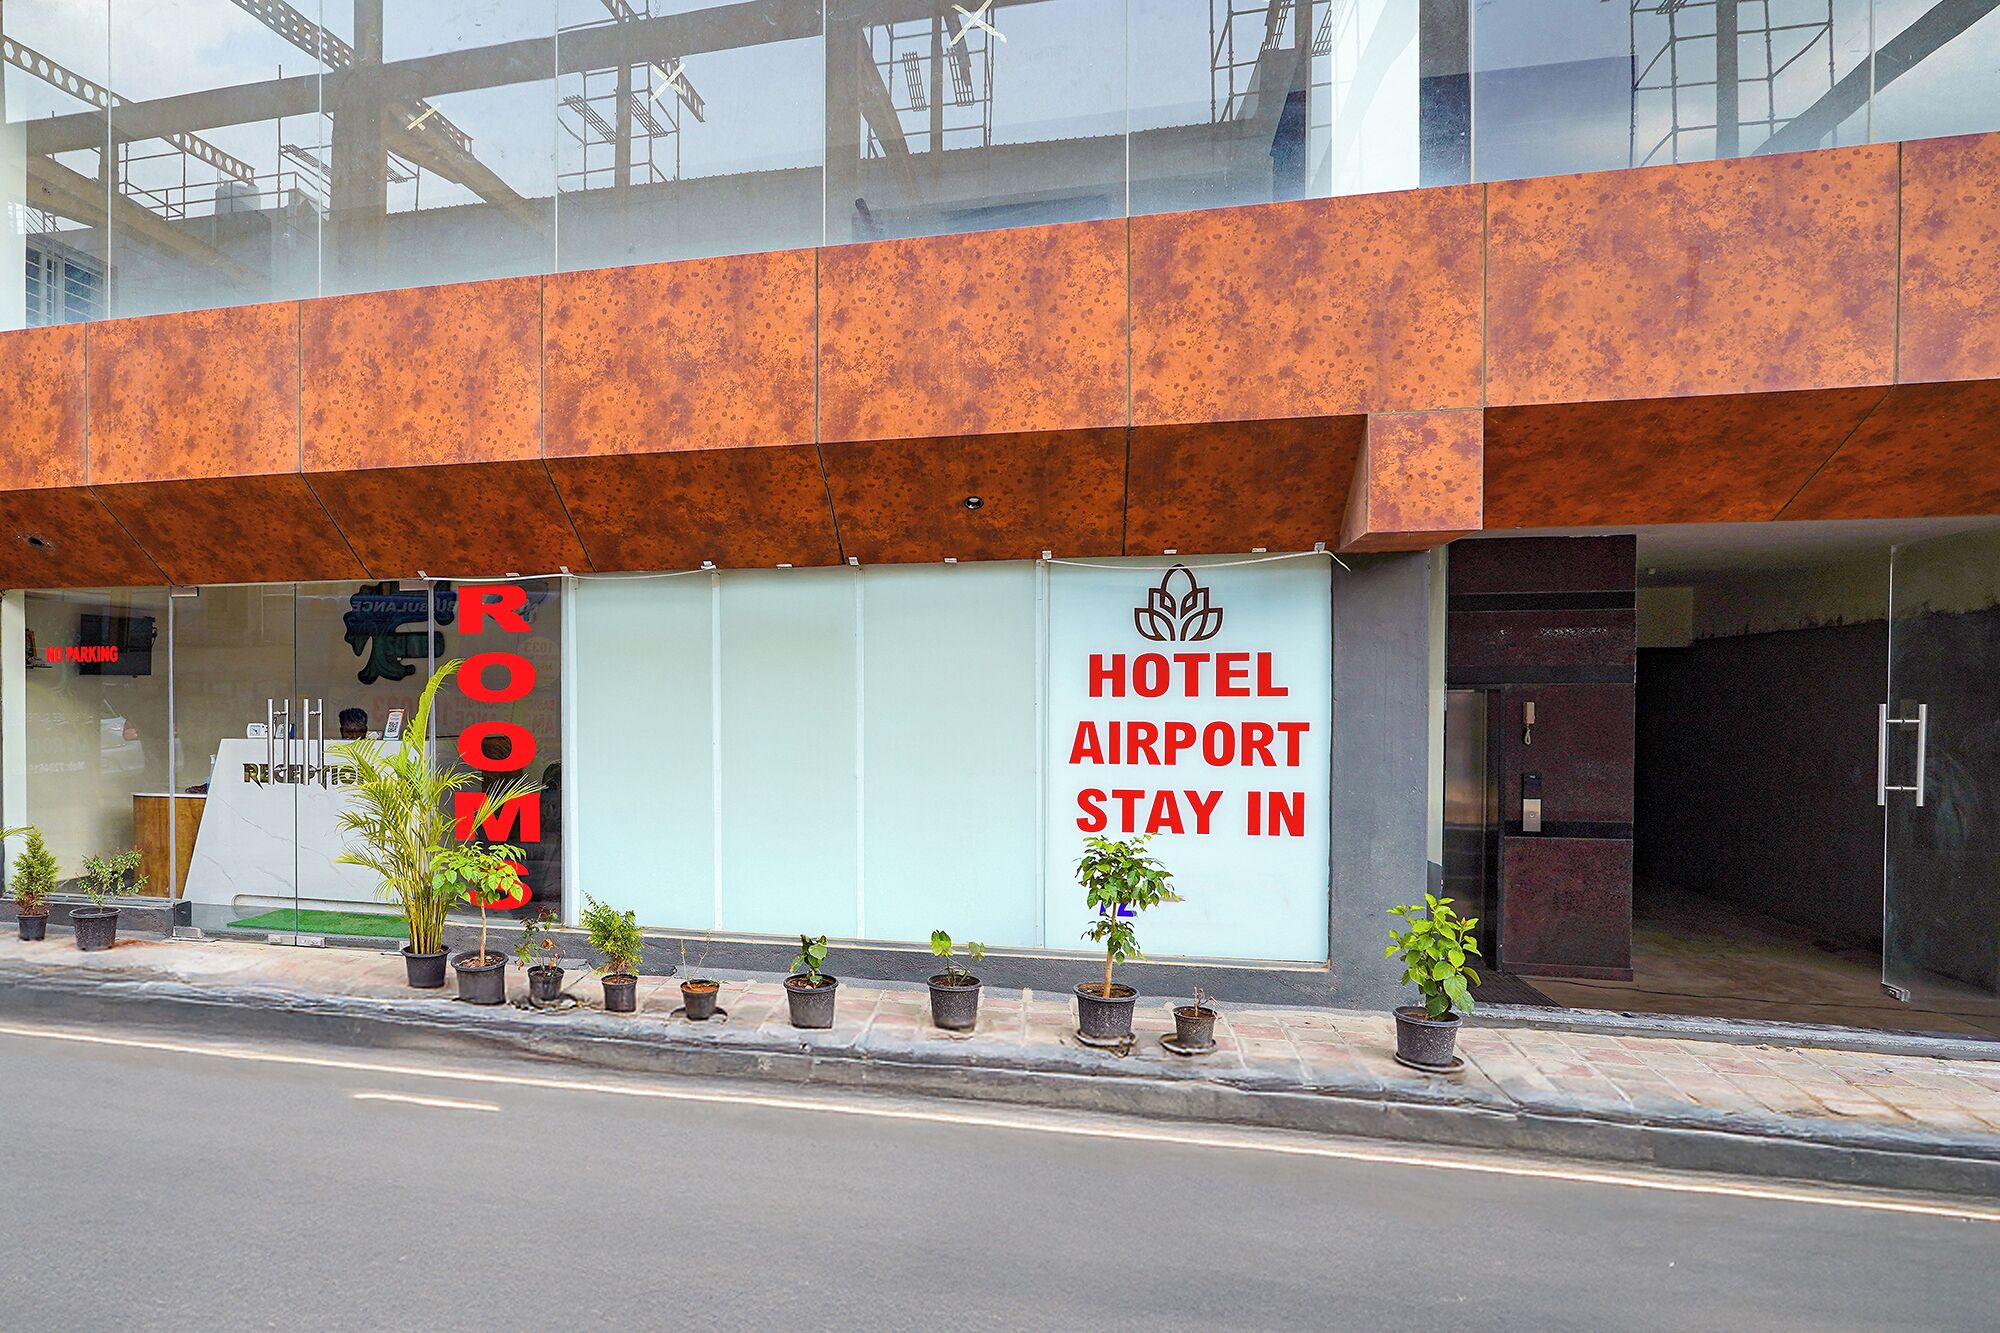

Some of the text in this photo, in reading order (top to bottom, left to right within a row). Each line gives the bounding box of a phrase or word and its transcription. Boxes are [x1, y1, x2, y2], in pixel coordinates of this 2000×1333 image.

[45, 645, 119, 663] NO PARKING
[1089, 652, 1289, 698] HOTEL
[455, 585, 541, 910] ROOMS
[1069, 720, 1311, 768] AIRPORT
[1075, 788, 1306, 838] STAY IN
